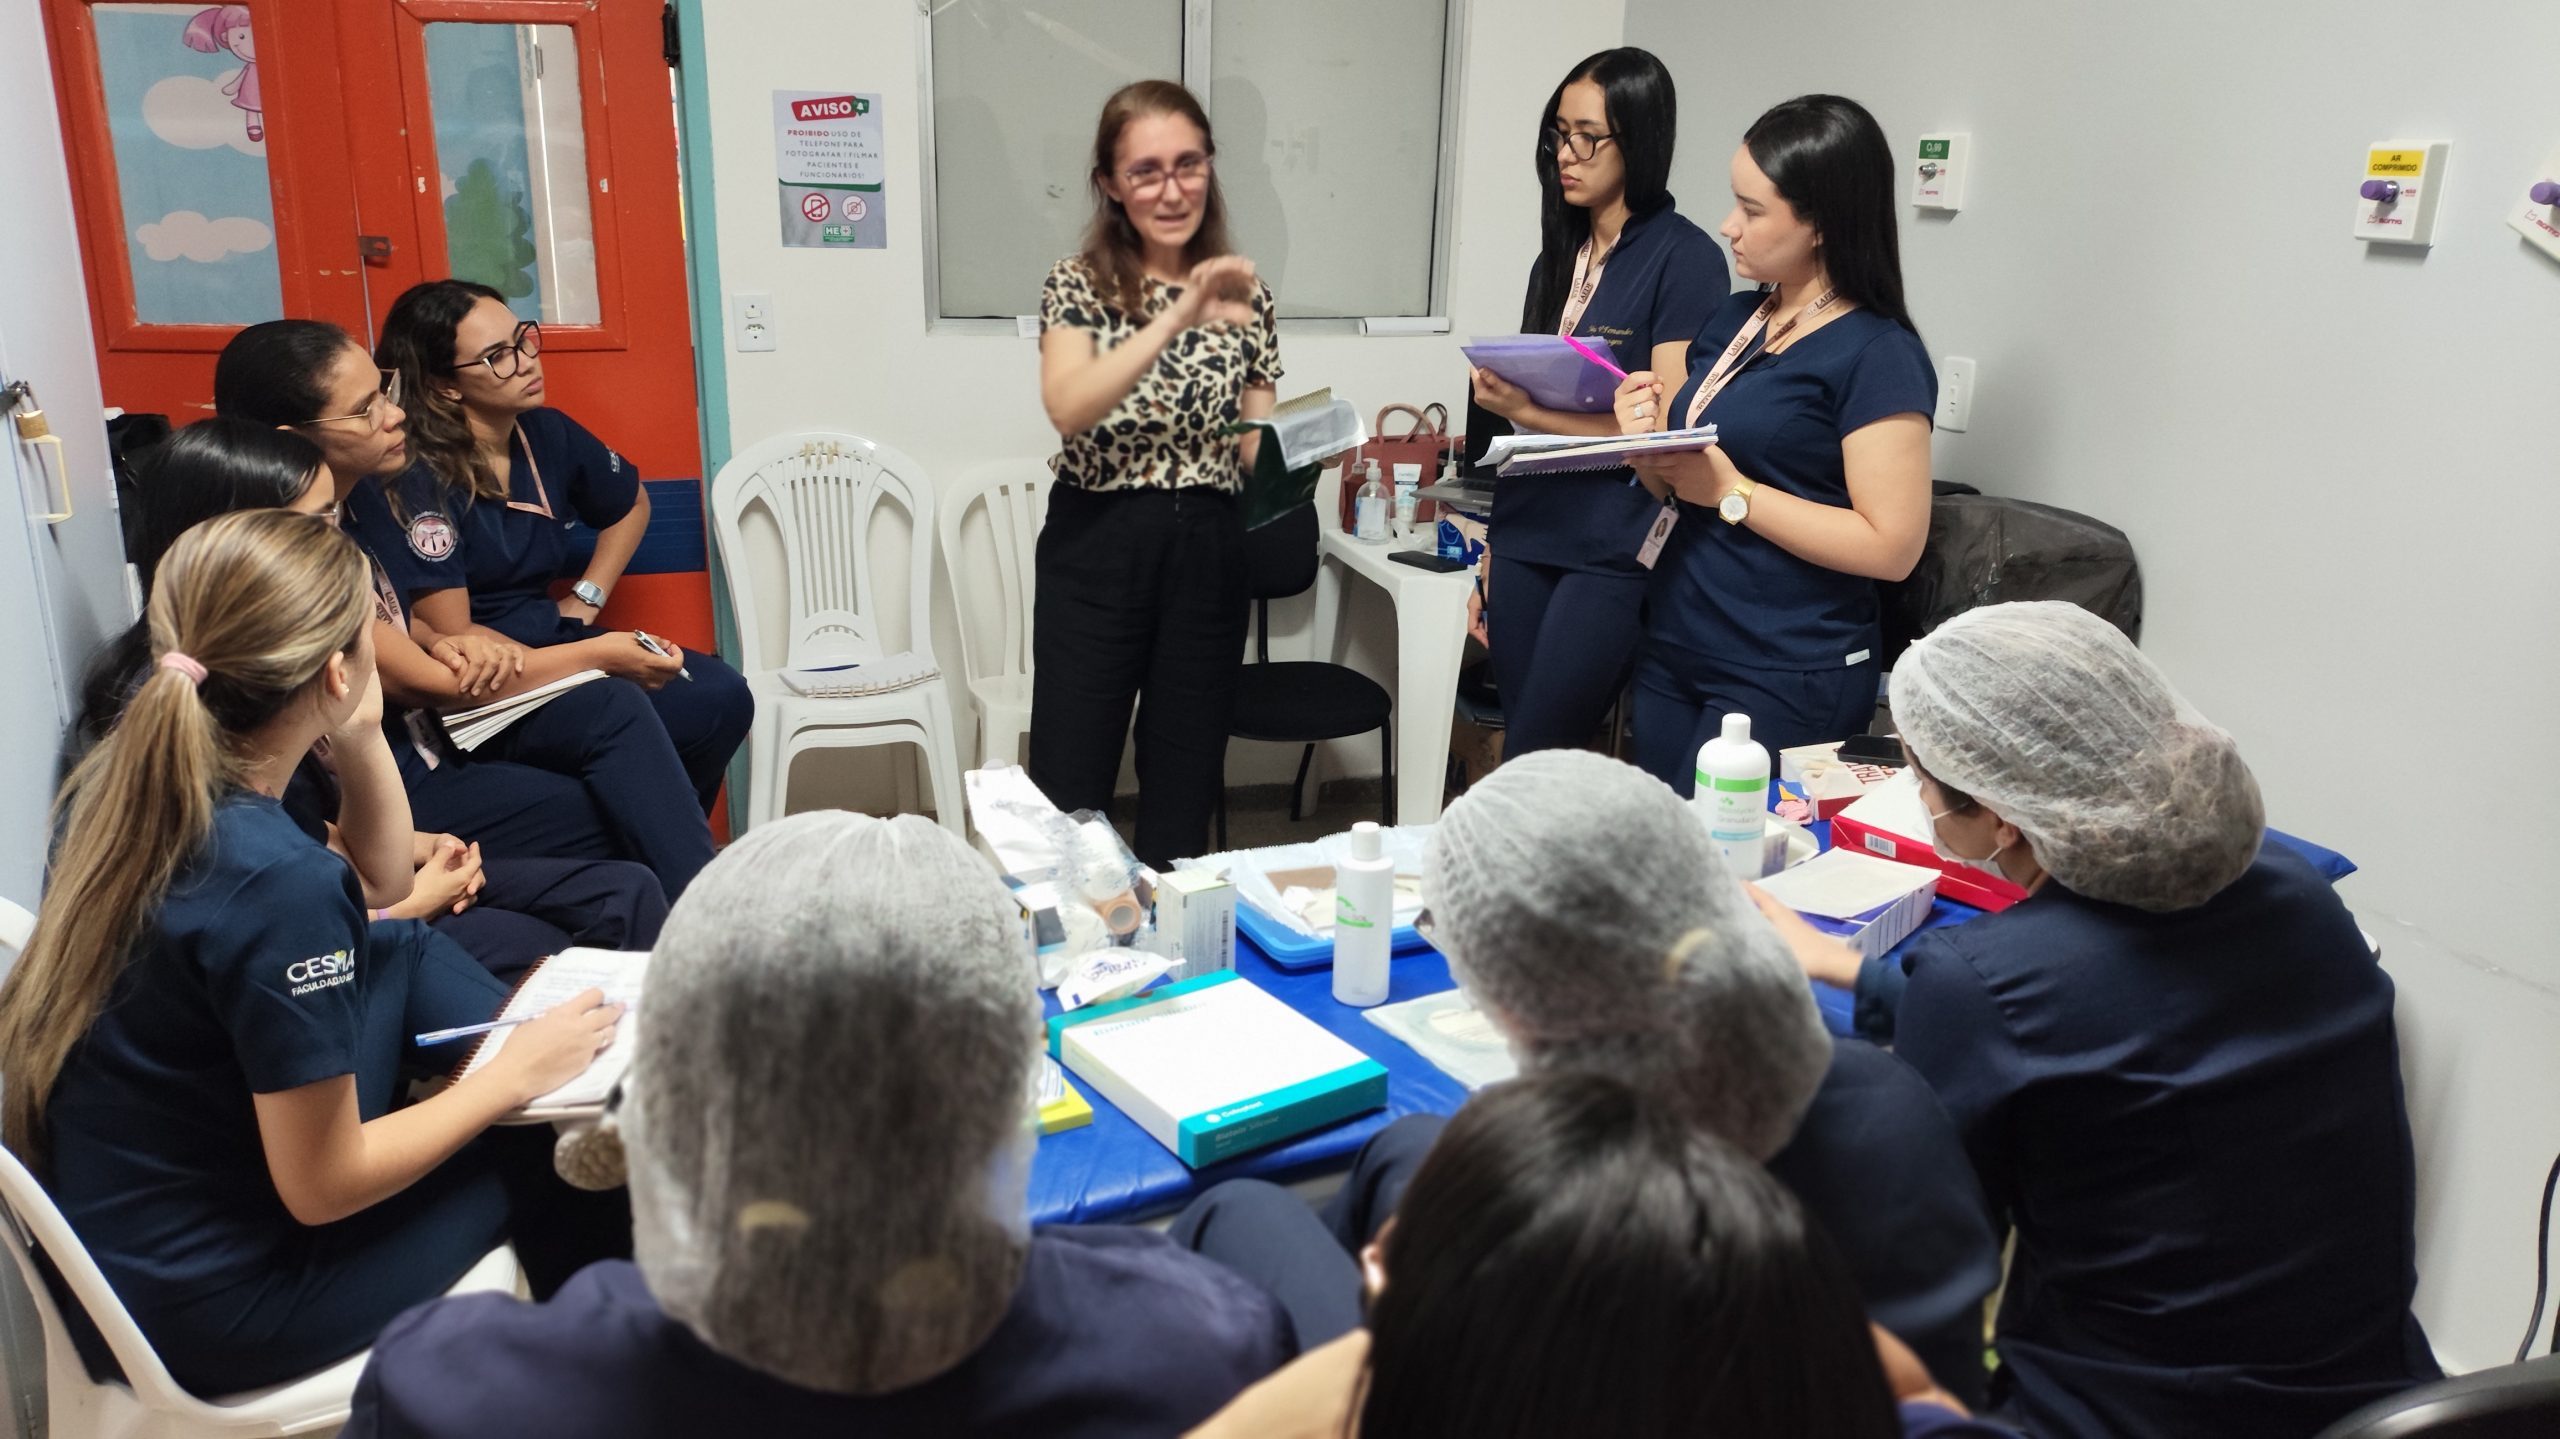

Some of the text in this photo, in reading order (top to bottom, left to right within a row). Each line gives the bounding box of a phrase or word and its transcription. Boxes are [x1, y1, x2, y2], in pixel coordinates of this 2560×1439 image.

[800, 101, 852, 118] AVISO
[787, 129, 830, 137] PROIBIDO
[831, 130, 849, 138] USO
[799, 140, 841, 148] TELEFONE
[785, 150, 841, 158] FOTOGRAFAR
[2391, 154, 2402, 162] AR
[807, 161, 853, 169] PACIENTES
[2372, 163, 2418, 172] COMPRIMIDO
